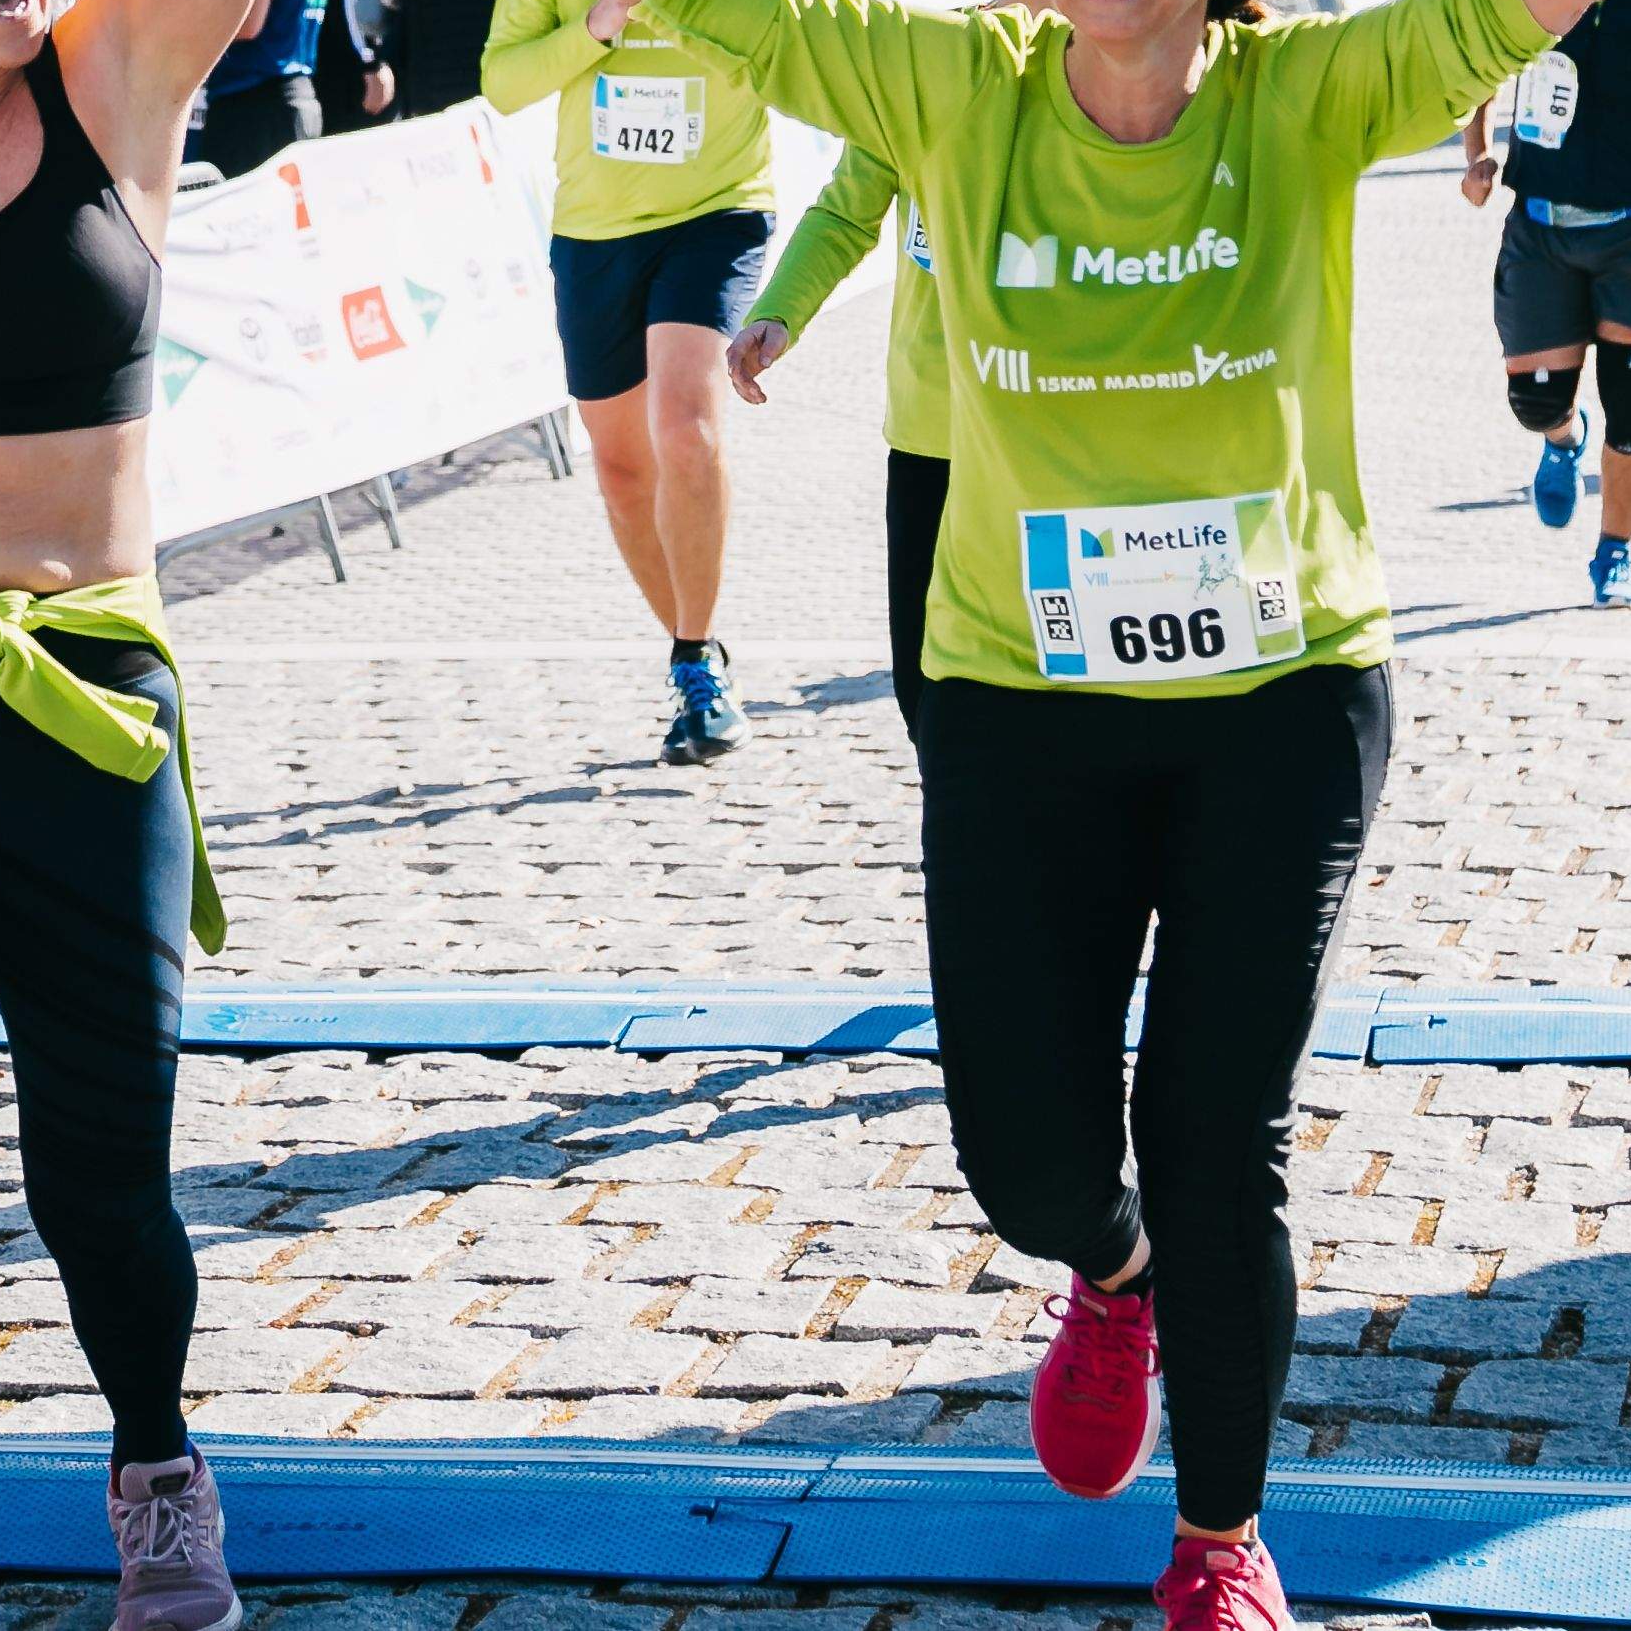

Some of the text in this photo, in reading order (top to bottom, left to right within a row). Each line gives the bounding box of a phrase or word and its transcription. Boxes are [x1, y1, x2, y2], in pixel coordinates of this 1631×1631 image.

[634, 88, 681, 99] MetLife
[618, 127, 674, 154] 4742
[1072, 227, 1240, 285] MetLife
[970, 340, 1031, 393] VIII
[1037, 376, 1097, 392] 15KM
[1125, 524, 1227, 552] MetLife
[1110, 607, 1226, 665] 696
